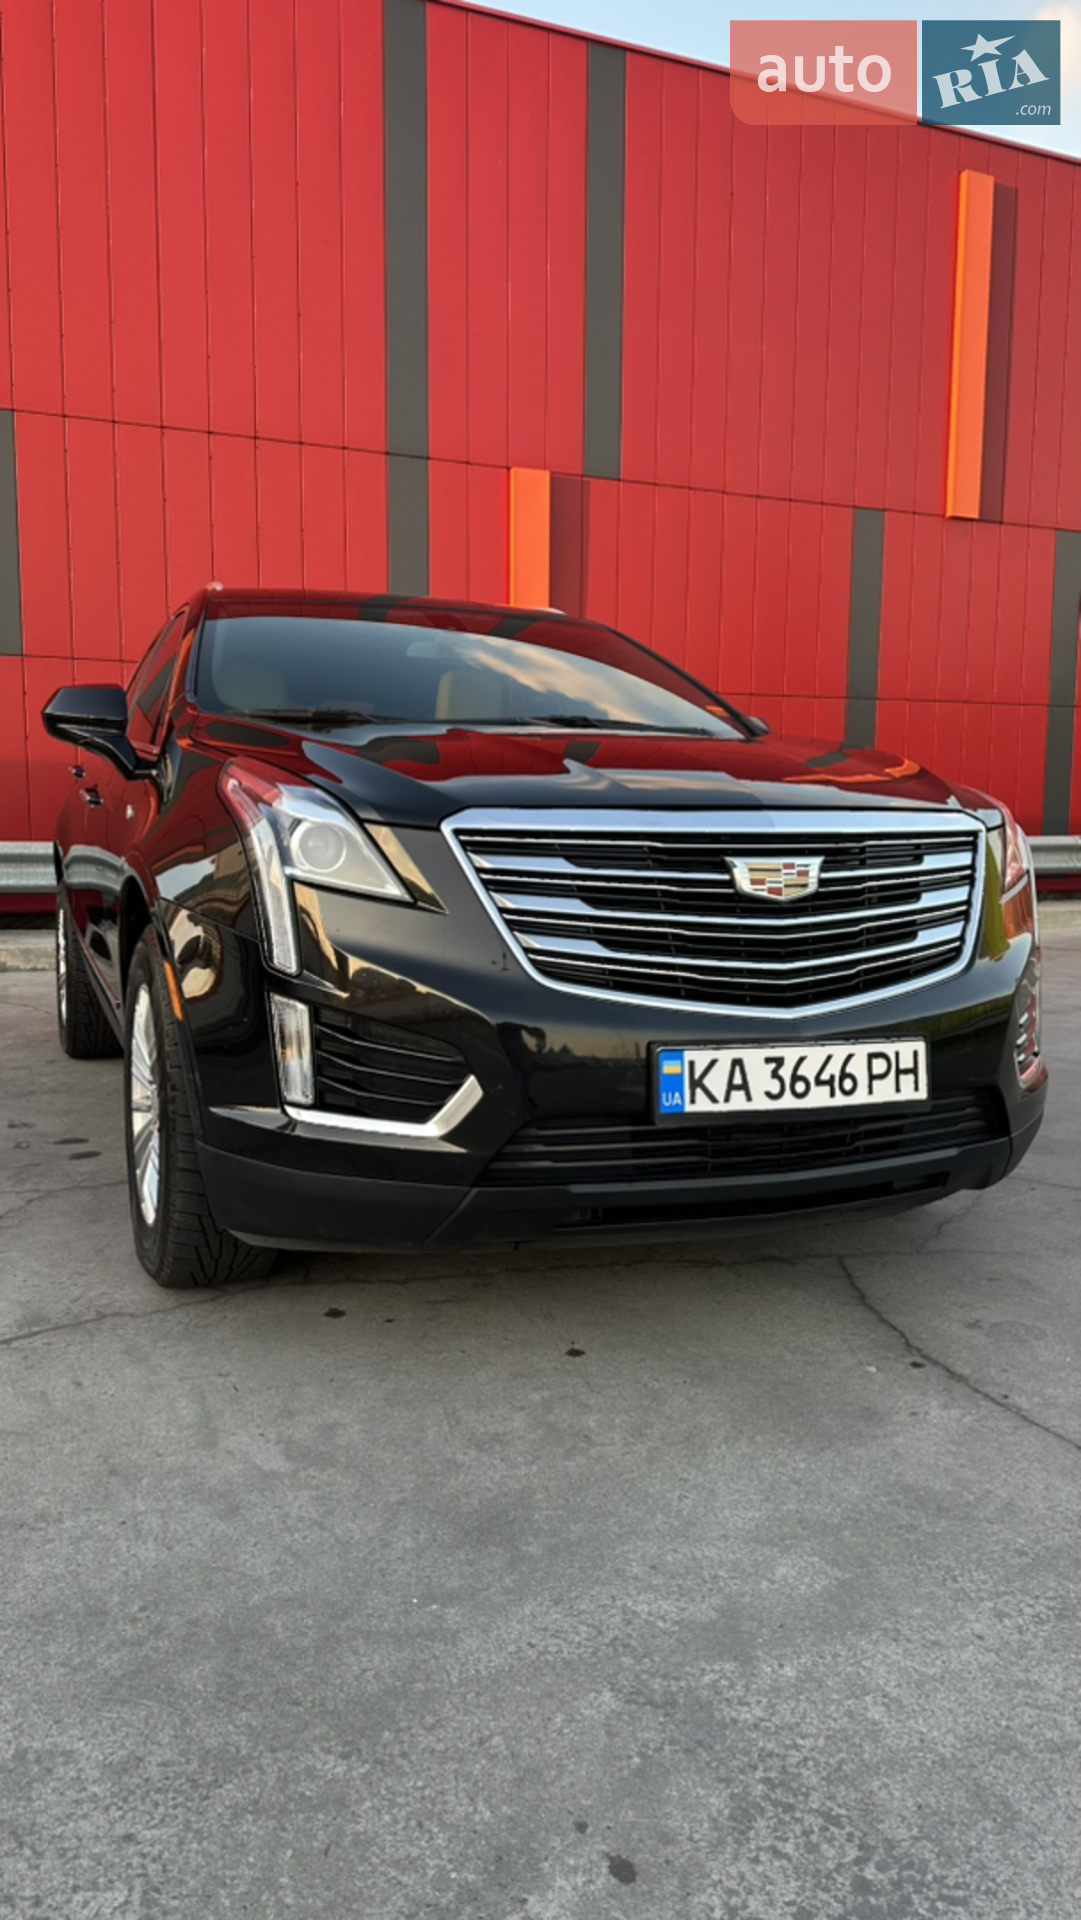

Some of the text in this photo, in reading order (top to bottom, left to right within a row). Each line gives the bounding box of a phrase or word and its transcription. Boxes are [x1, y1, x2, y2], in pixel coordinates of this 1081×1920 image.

[688, 1049, 919, 1105] KA 3646 PH
[662, 1091, 683, 1107] UA
